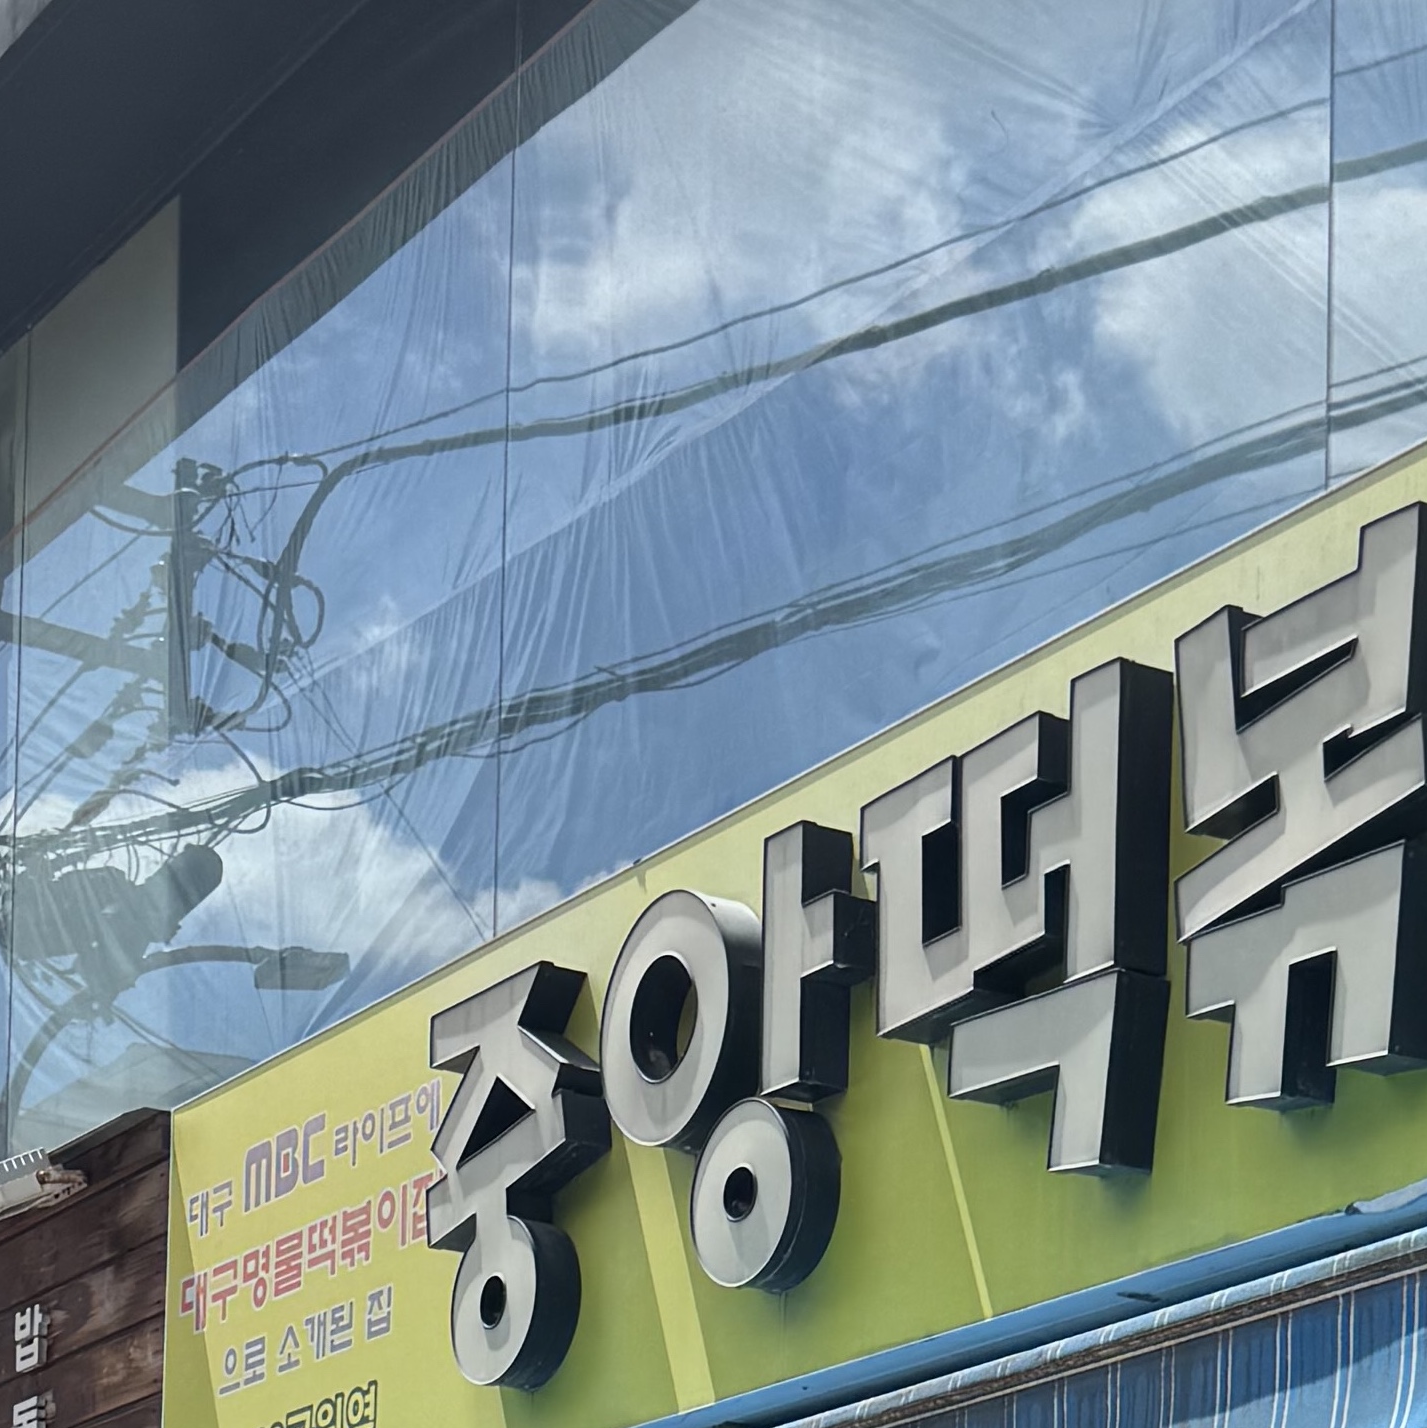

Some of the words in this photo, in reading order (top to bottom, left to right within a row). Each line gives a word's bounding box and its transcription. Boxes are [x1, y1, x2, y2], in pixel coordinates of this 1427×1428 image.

[188, 1180, 235, 1238] 대구
[243, 1112, 327, 1213] MBC
[334, 1077, 443, 1167] 라이프에
[217, 1334, 267, 1396] 으로
[277, 1300, 355, 1375] 소개된
[366, 1283, 394, 1340] 집
